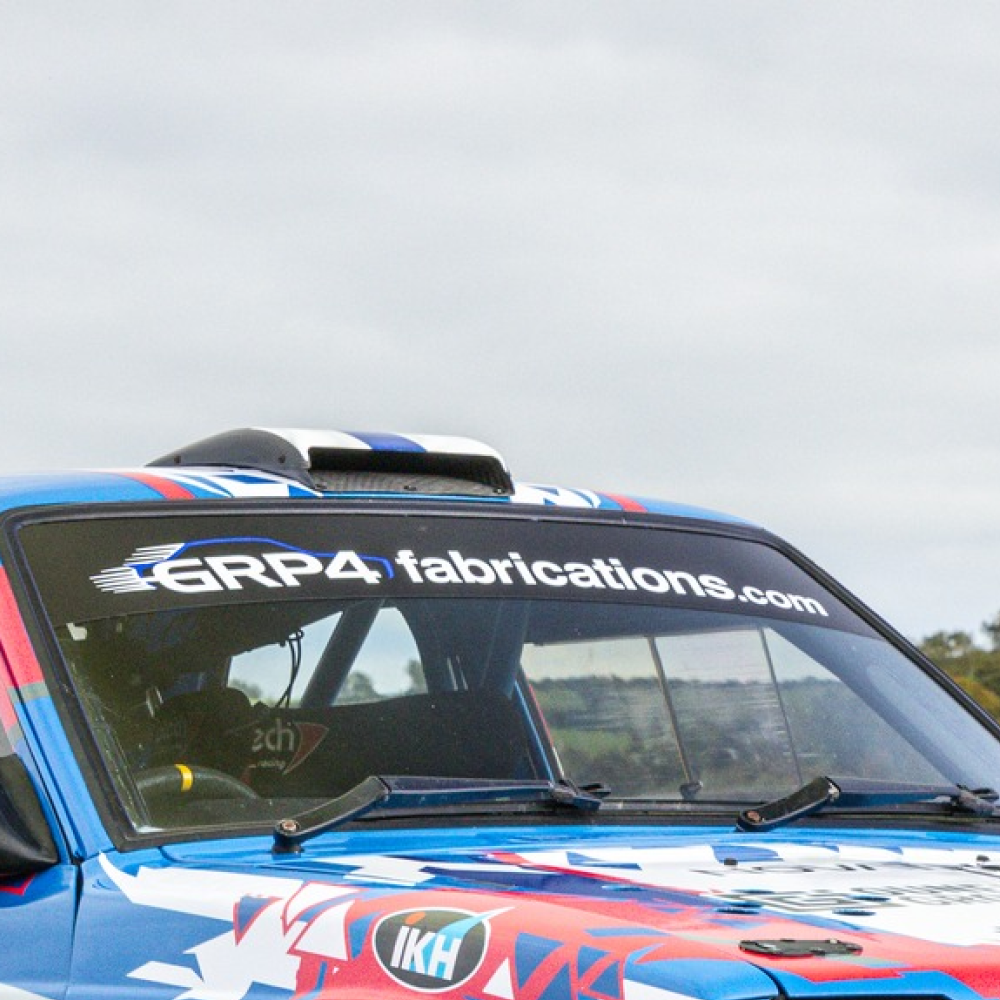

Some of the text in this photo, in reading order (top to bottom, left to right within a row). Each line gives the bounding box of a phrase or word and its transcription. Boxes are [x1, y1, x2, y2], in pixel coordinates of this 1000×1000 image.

[151, 549, 829, 617] GRP4 fabrications.com
[389, 925, 463, 981] IKH
